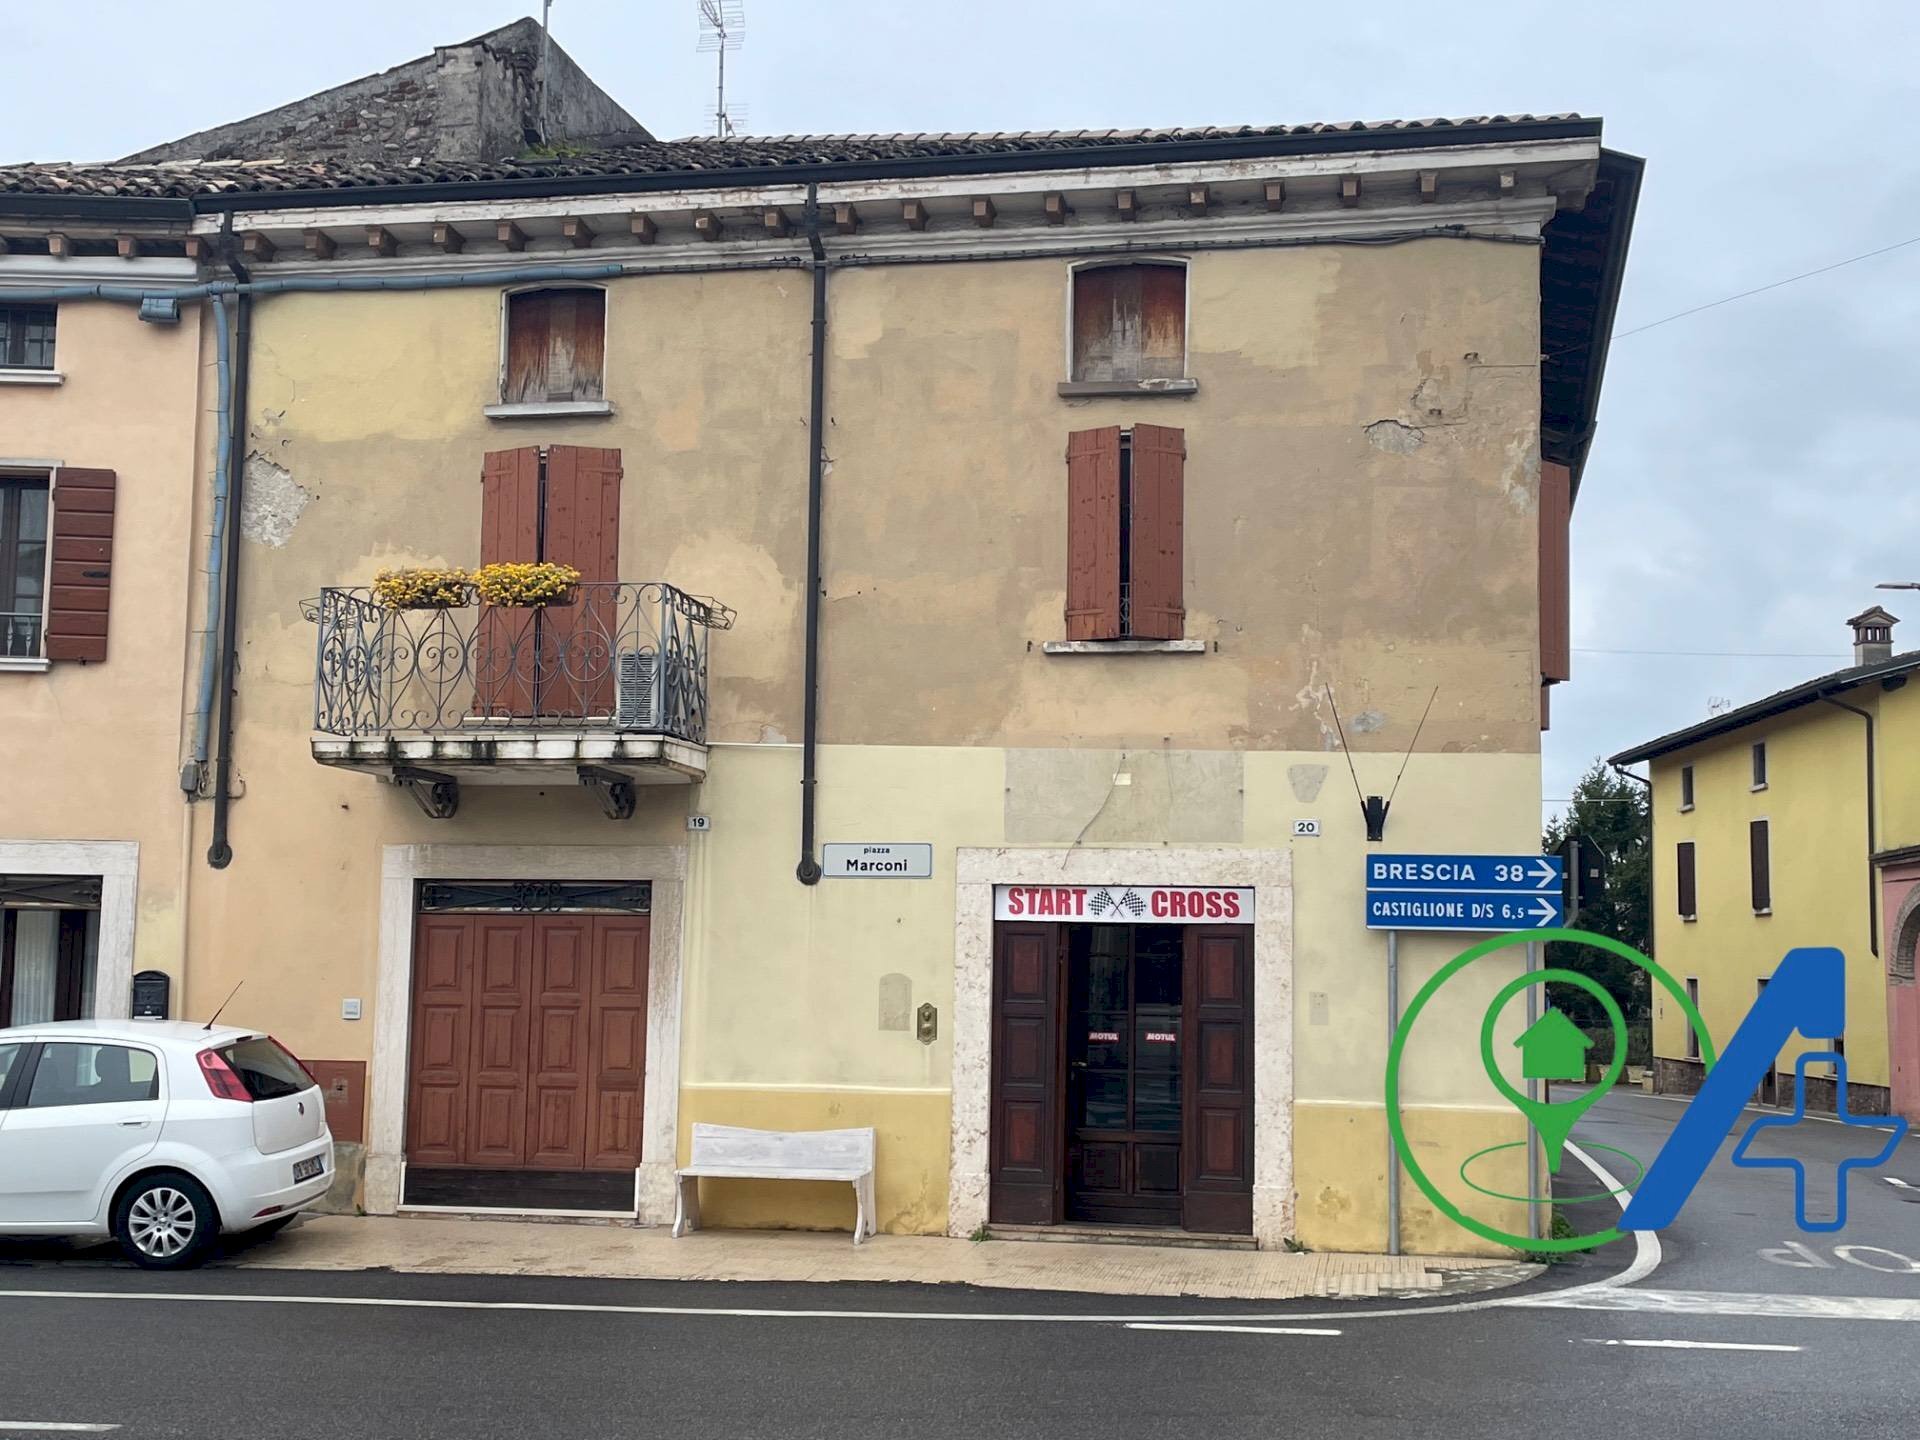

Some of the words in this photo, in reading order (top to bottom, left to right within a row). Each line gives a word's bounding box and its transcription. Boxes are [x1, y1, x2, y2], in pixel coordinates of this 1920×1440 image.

[693, 817, 705, 828] 19
[1297, 822, 1315, 833] 20
[863, 846, 890, 855] piazza
[846, 859, 908, 872] Marconi
[1373, 863, 1476, 881] BRESCIA
[1494, 864, 1524, 882] 38
[1008, 887, 1088, 916] START
[1151, 890, 1241, 918] CROSS
[1373, 902, 1464, 918] CASTIGLIONE
[1471, 904, 1494, 919] D/S
[1502, 904, 1525, 920] 6,5
[1088, 1032, 1119, 1041] MOTUL
[1146, 1032, 1176, 1042] MOTUL
